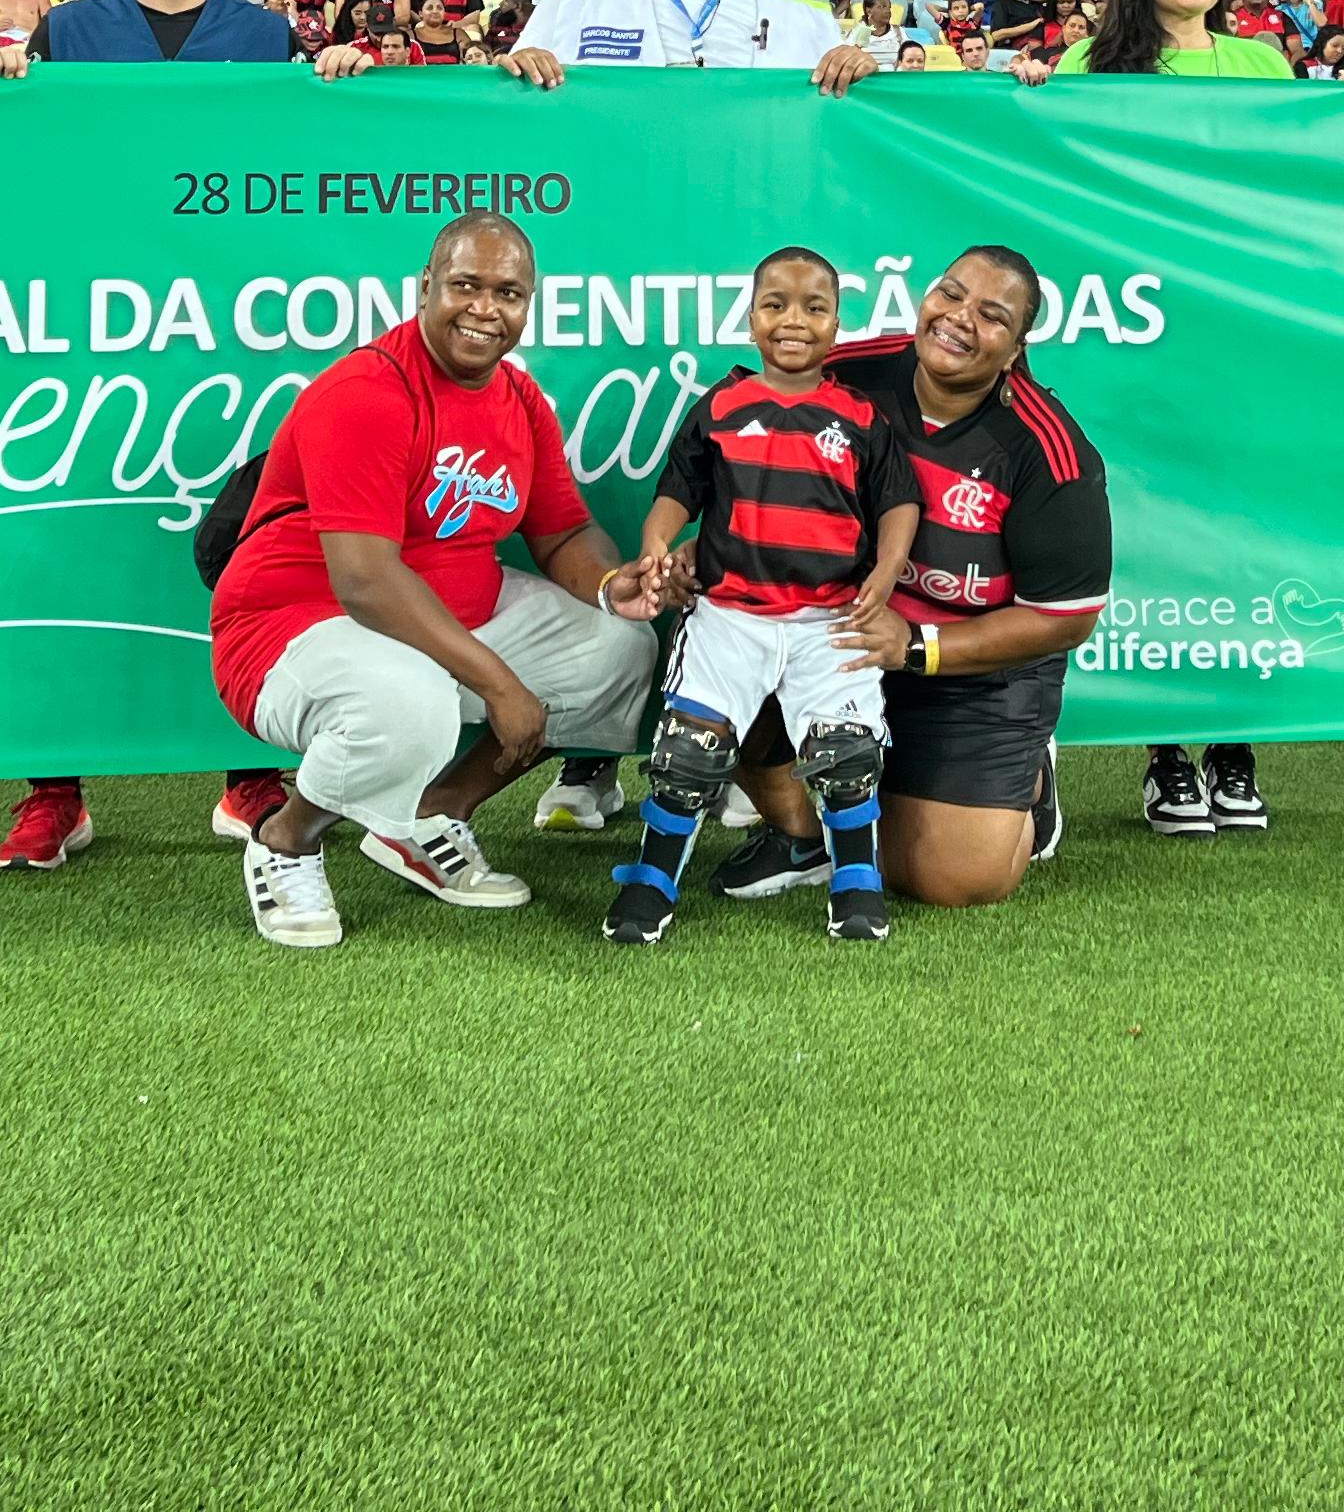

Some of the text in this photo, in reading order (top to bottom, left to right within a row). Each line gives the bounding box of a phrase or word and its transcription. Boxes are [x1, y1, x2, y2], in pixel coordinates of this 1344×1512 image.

[584, 46, 631, 56] PRESIDENTE
[611, 29, 639, 40] SANTOS
[172, 172, 572, 215] 28 DE FEVEREIRO
[90, 277, 218, 352] DA
[1097, 588, 1274, 627] brace a
[1074, 629, 1305, 680] diferença
